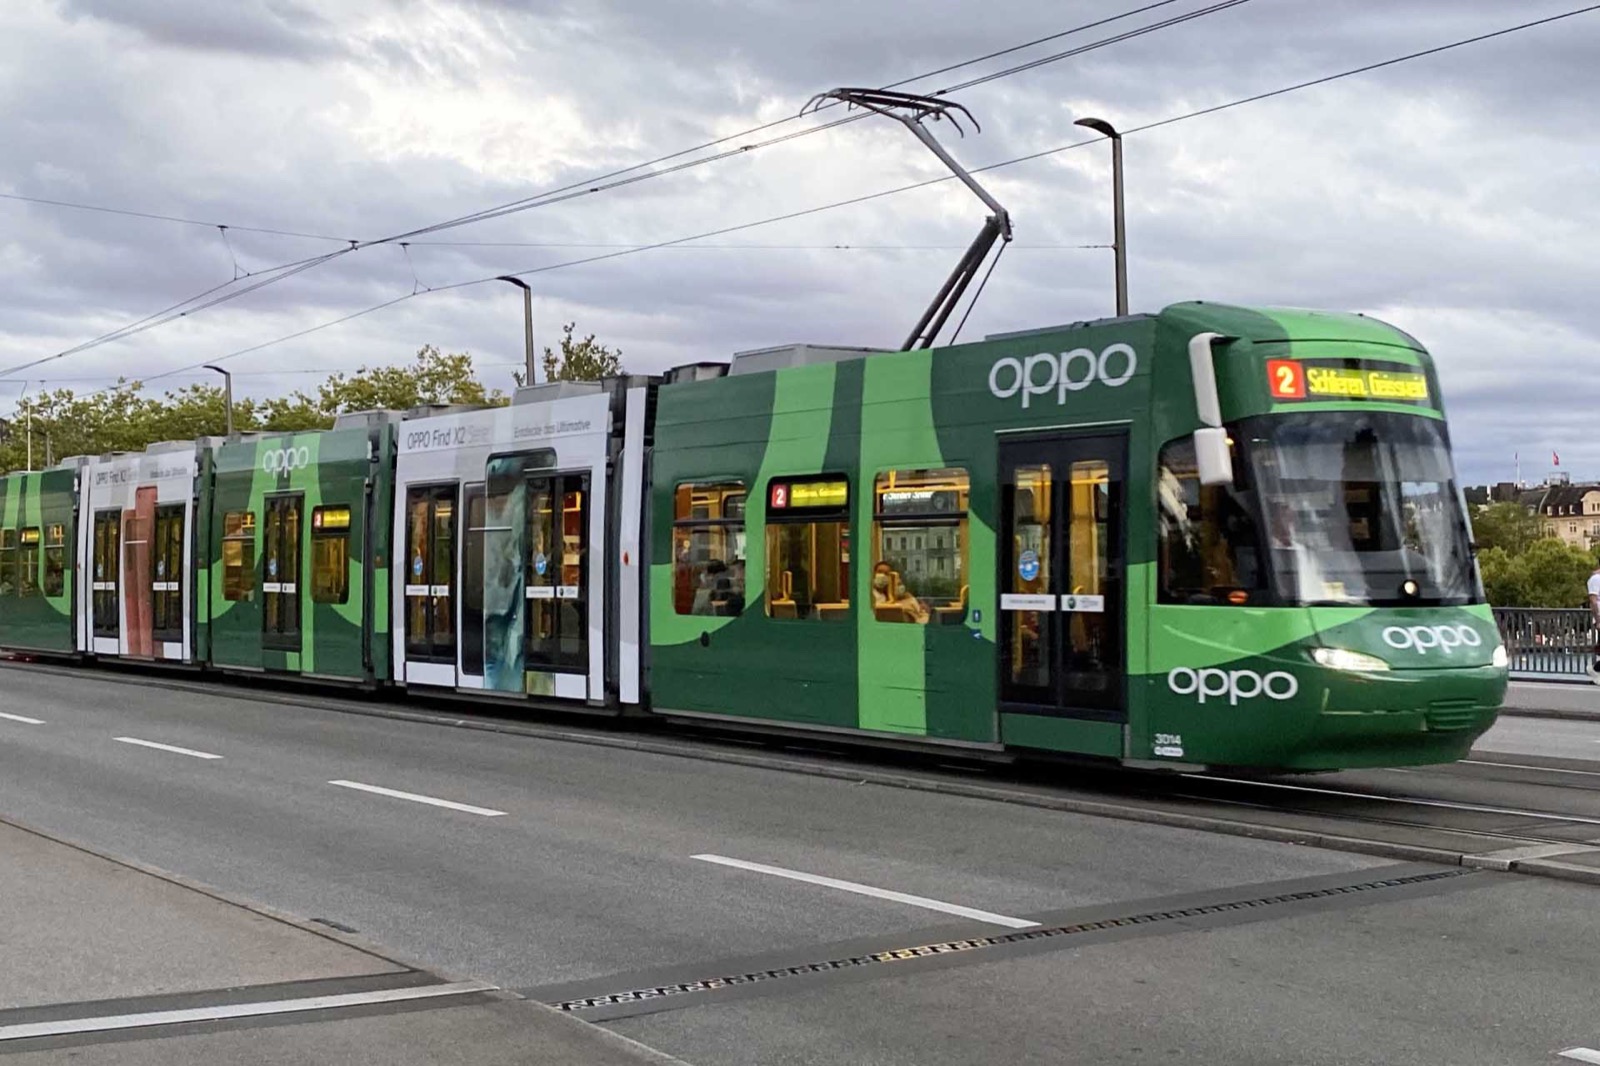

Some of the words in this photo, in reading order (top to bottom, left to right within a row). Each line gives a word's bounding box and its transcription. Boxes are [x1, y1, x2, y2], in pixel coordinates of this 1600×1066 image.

[989, 343, 1137, 408] oppo
[1276, 366, 1296, 393] 2
[408, 430, 430, 449] OPPO
[433, 427, 451, 447] Find
[453, 426, 465, 444] X2
[263, 446, 309, 479] oppo
[776, 487, 784, 505] 2
[1382, 625, 1481, 654] oppo
[1168, 667, 1298, 705] oppo
[1155, 733, 1182, 745] 3014
